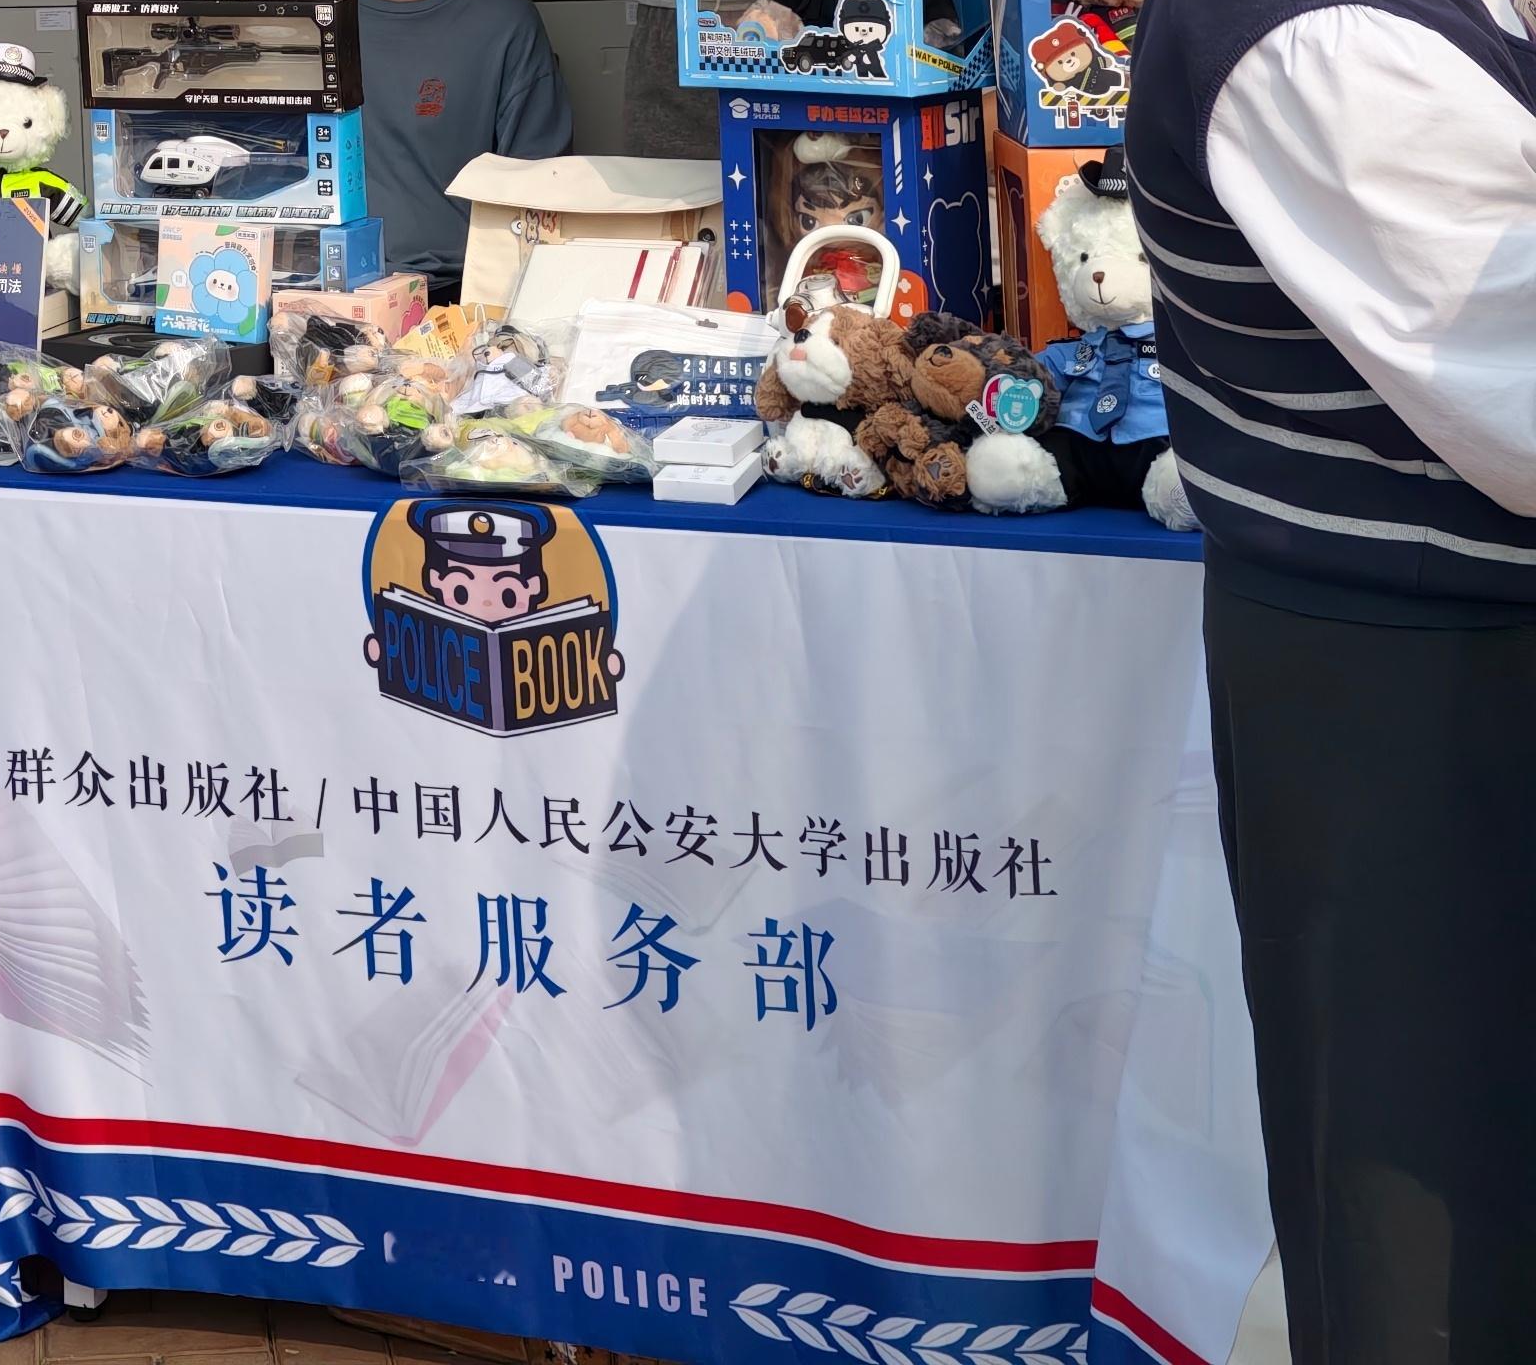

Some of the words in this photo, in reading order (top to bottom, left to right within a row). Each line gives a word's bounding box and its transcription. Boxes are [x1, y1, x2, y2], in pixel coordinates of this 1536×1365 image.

[323, 94, 338, 105] 15+
[317, 127, 330, 138] 3+
[683, 358, 691, 373] 2
[698, 360, 706, 374] 3
[714, 361, 722, 375] 4
[729, 361, 737, 376] 5
[745, 362, 753, 377] 6
[676, 395, 732, 406] 临时停靠
[381, 610, 488, 723] POLICE
[511, 625, 609, 722] BOOK
[4, 746, 296, 824] 群众出版社
[351, 774, 1059, 899] 中国人民公安大学出版社
[205, 860, 838, 1033] 读者服务部
[552, 1254, 709, 1317] POLICE
